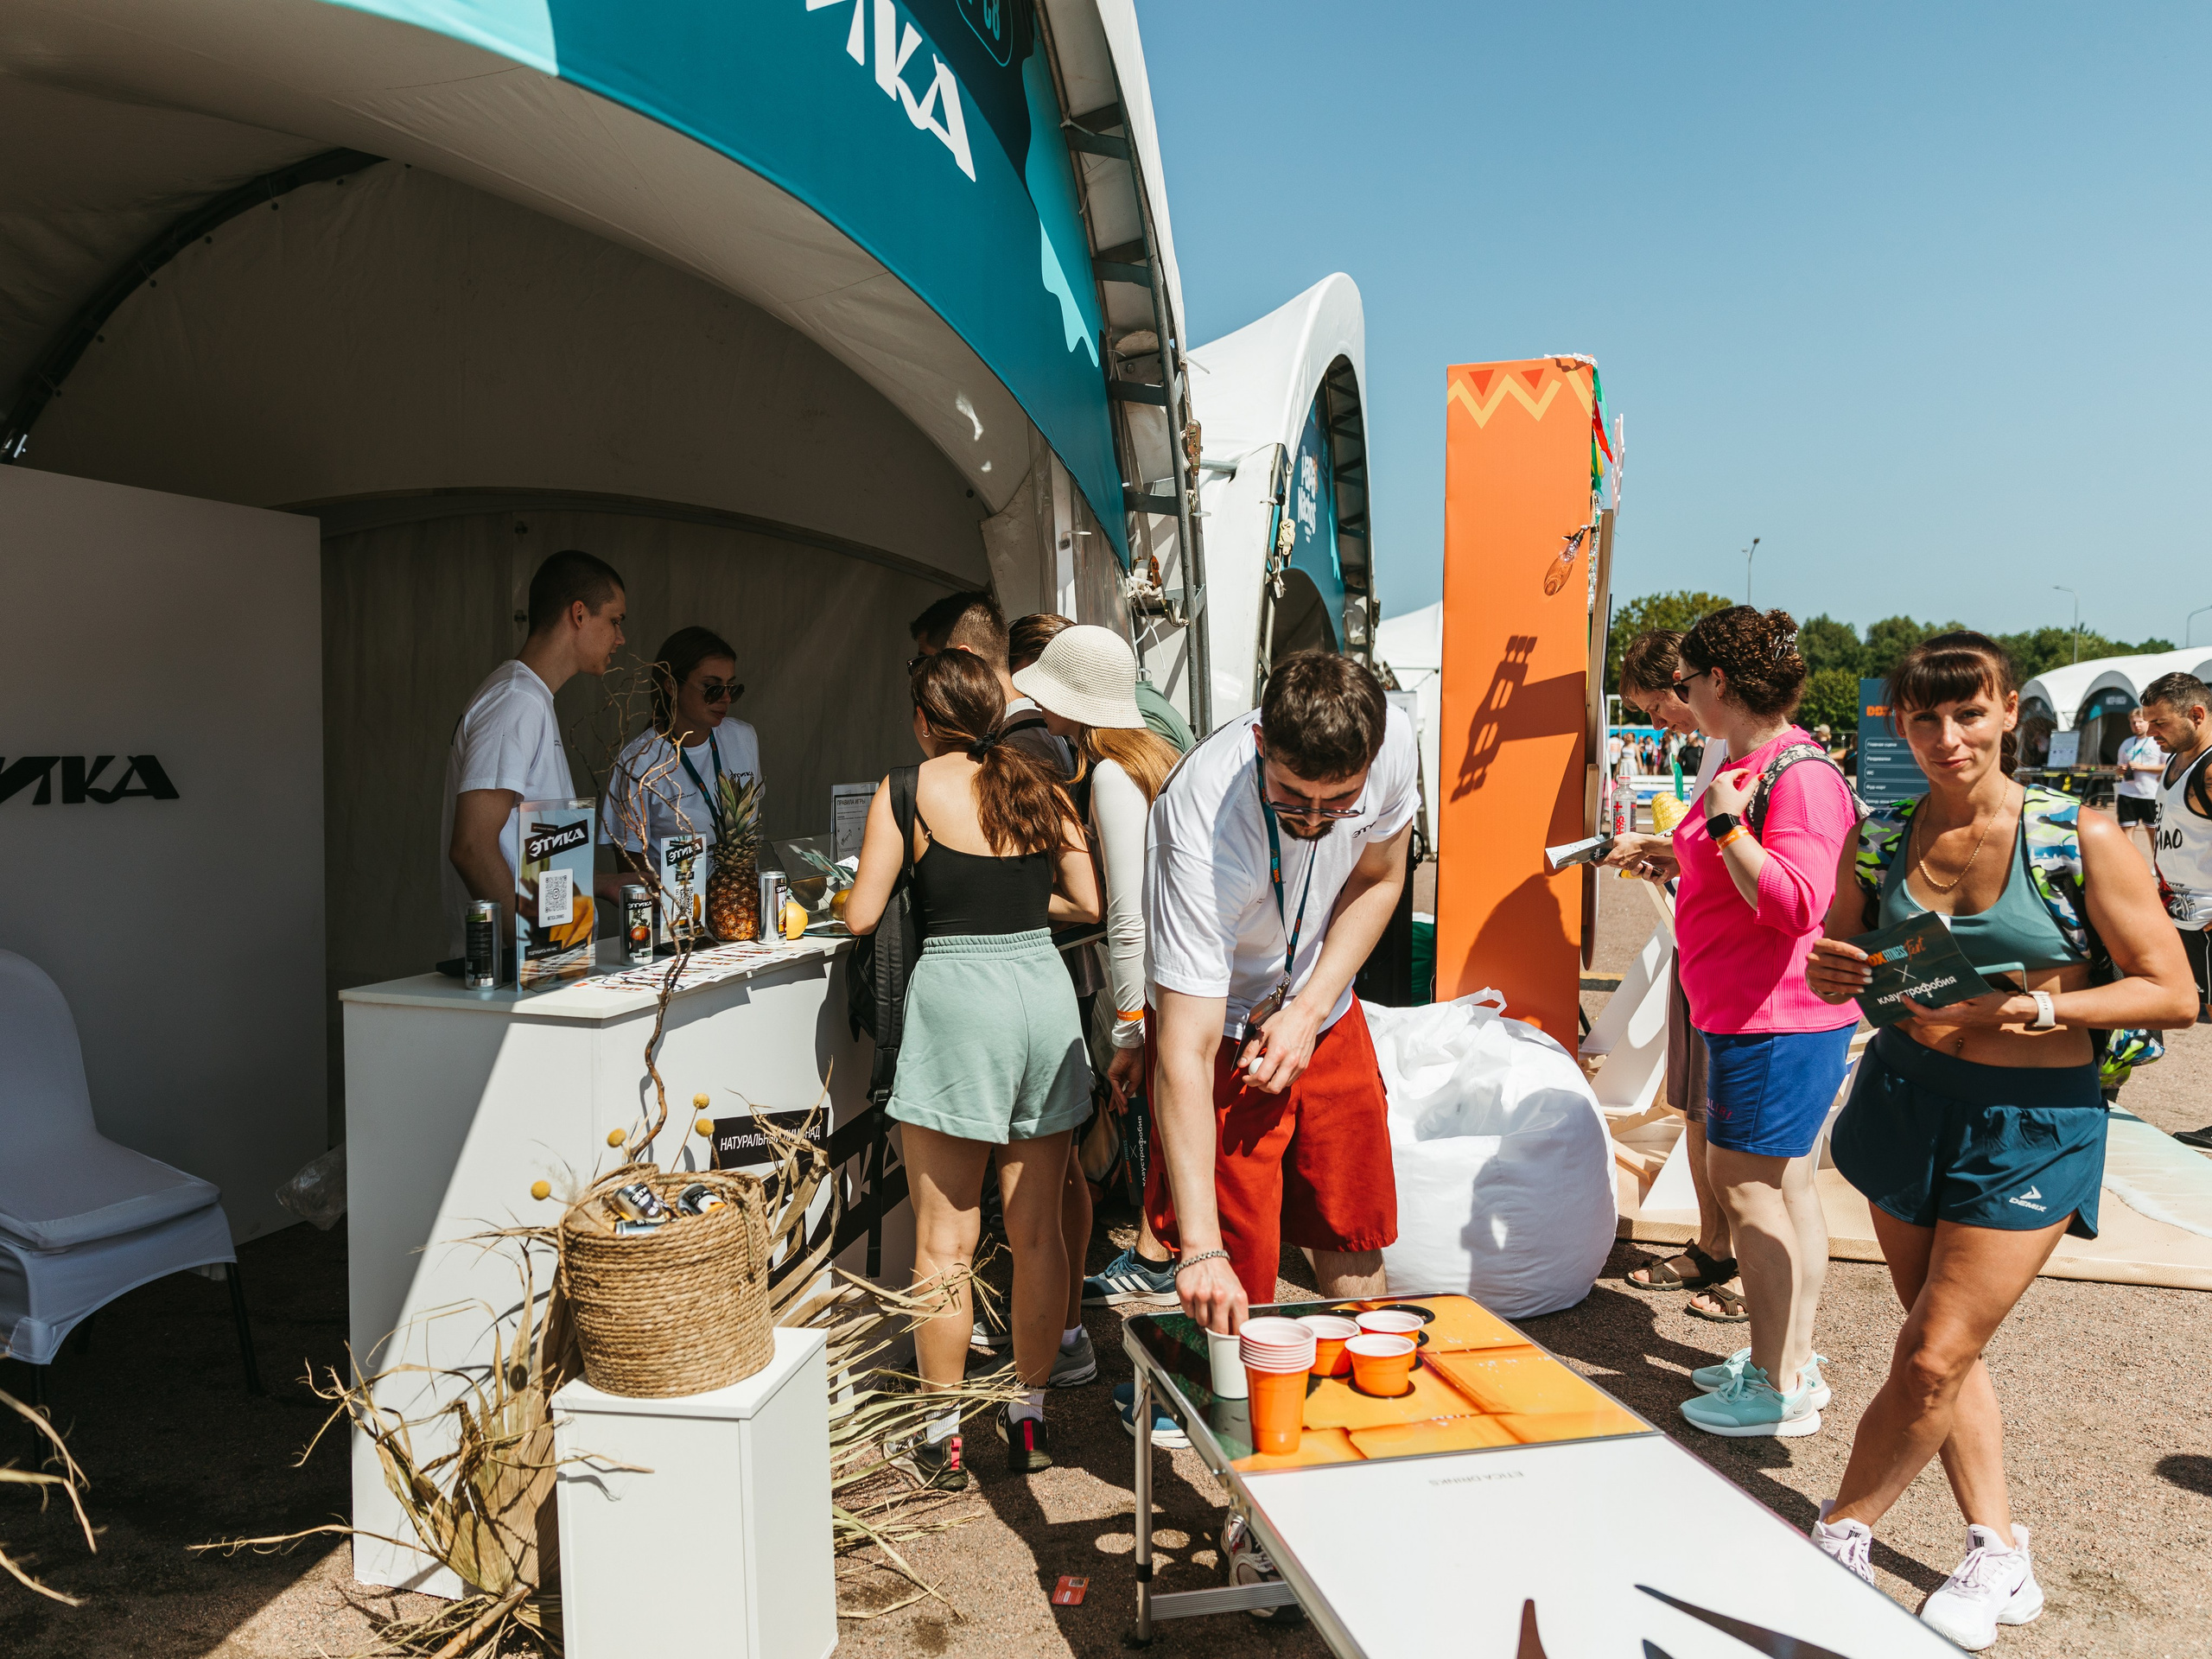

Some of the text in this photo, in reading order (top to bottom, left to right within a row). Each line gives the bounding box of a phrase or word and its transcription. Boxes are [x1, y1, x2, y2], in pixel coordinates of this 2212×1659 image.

[529, 828, 585, 857] ЭТИКА
[2156, 826, 2183, 850] IAO
[783, 1125, 821, 1143] ЛИМНАД
[2008, 1197, 2047, 1212] DEMIX
